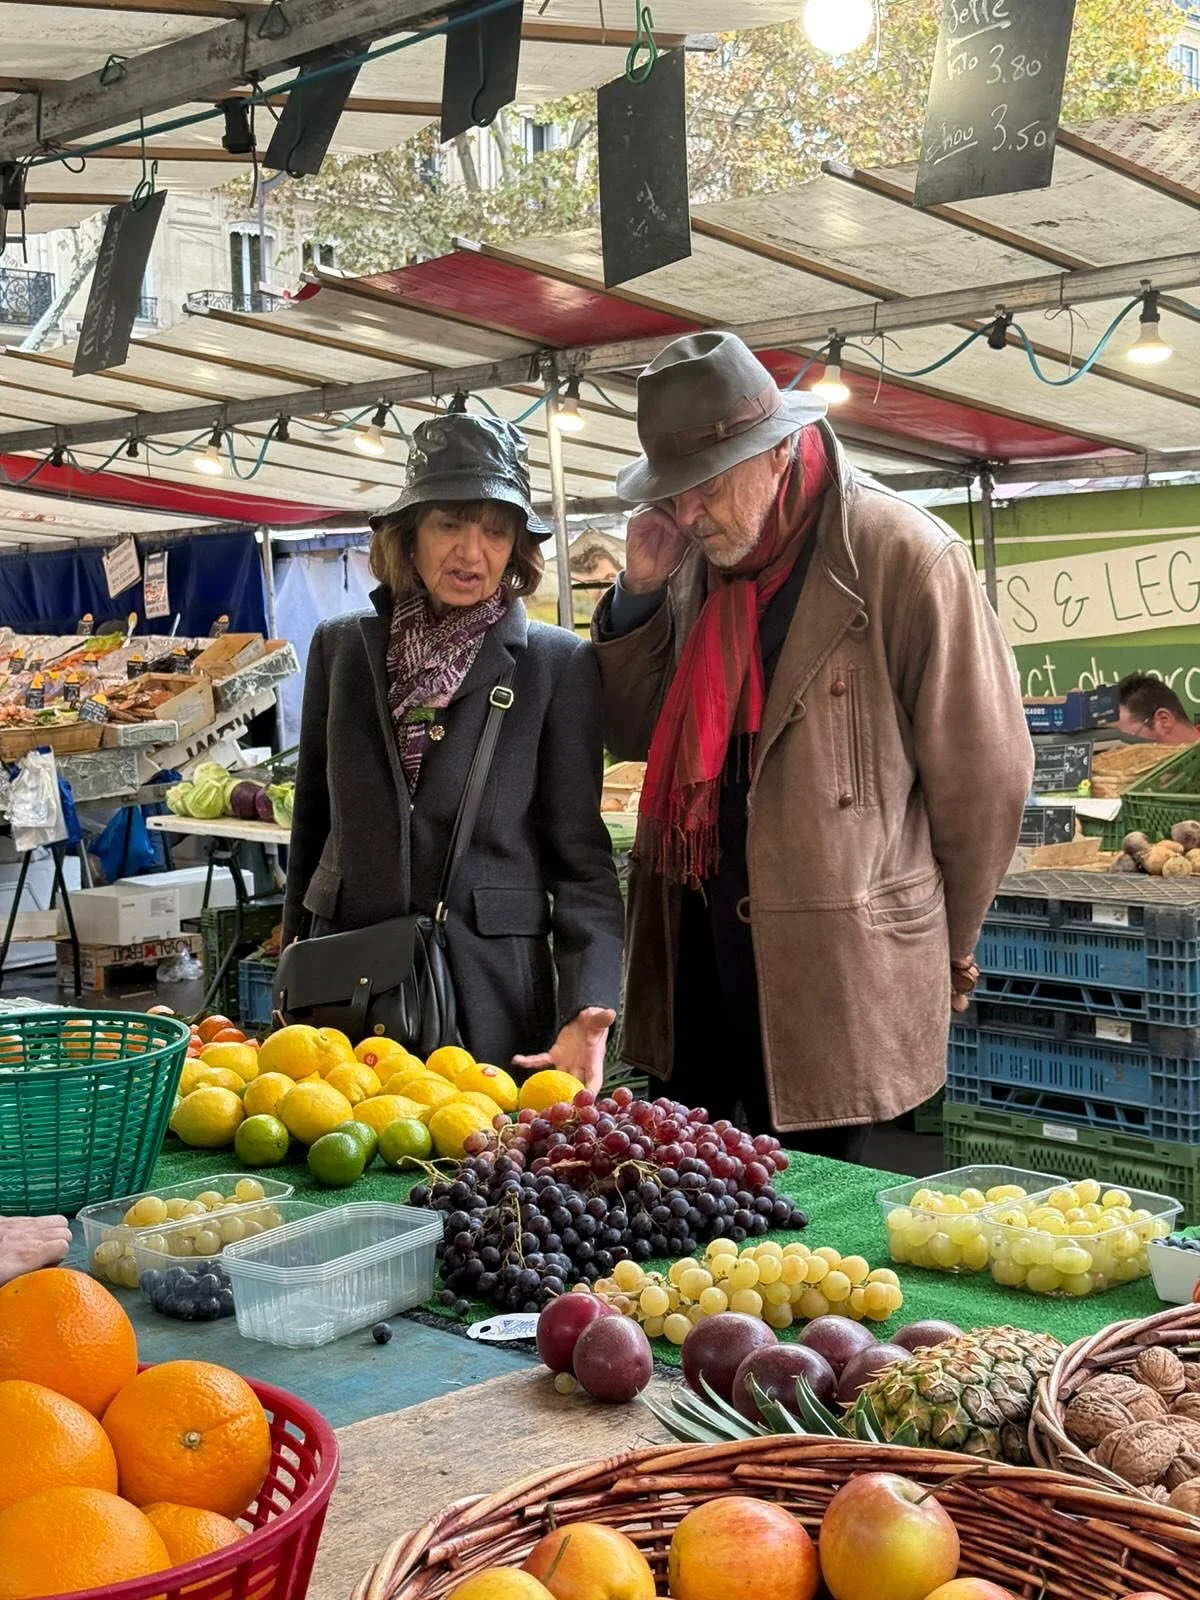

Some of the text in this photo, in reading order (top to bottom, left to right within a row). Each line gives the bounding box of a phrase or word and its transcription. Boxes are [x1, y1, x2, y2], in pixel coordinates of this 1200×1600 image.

[986, 44, 1041, 84] 3.80
[991, 104, 1046, 151] 3.50
[1053, 571, 1090, 628] &
